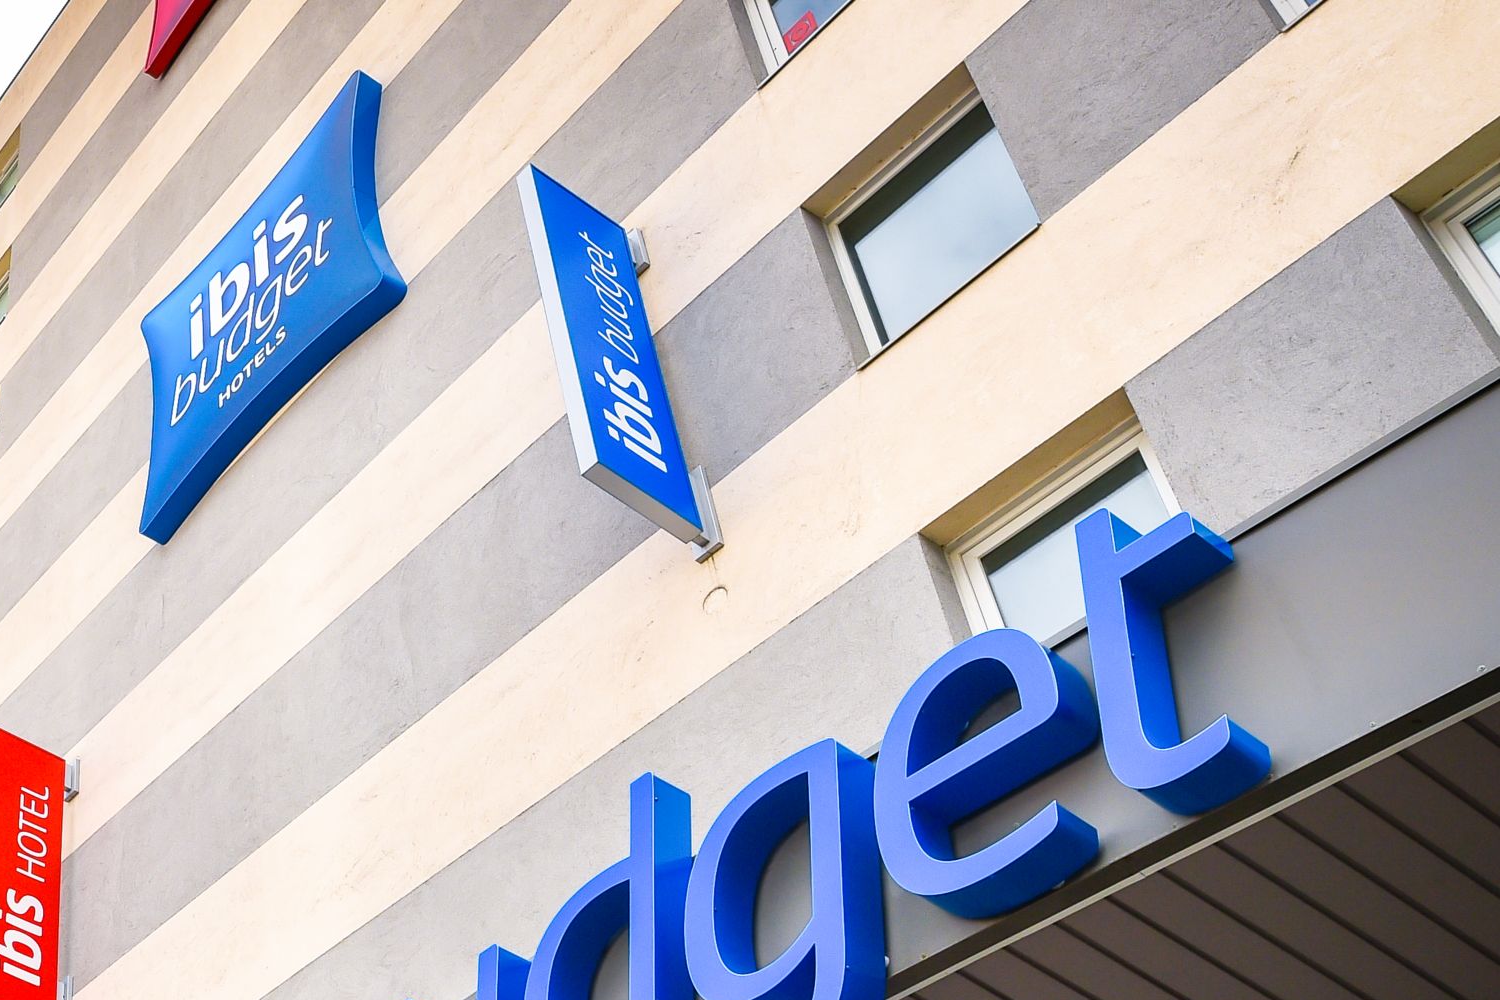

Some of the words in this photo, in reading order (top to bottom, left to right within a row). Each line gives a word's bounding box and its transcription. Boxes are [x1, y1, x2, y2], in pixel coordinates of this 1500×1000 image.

[171, 217, 332, 426] budget
[190, 195, 309, 356] ibis
[579, 231, 640, 364] budget
[218, 326, 287, 408] HOTELS
[594, 355, 667, 472] ibis
[17, 785, 50, 883] HOTEL
